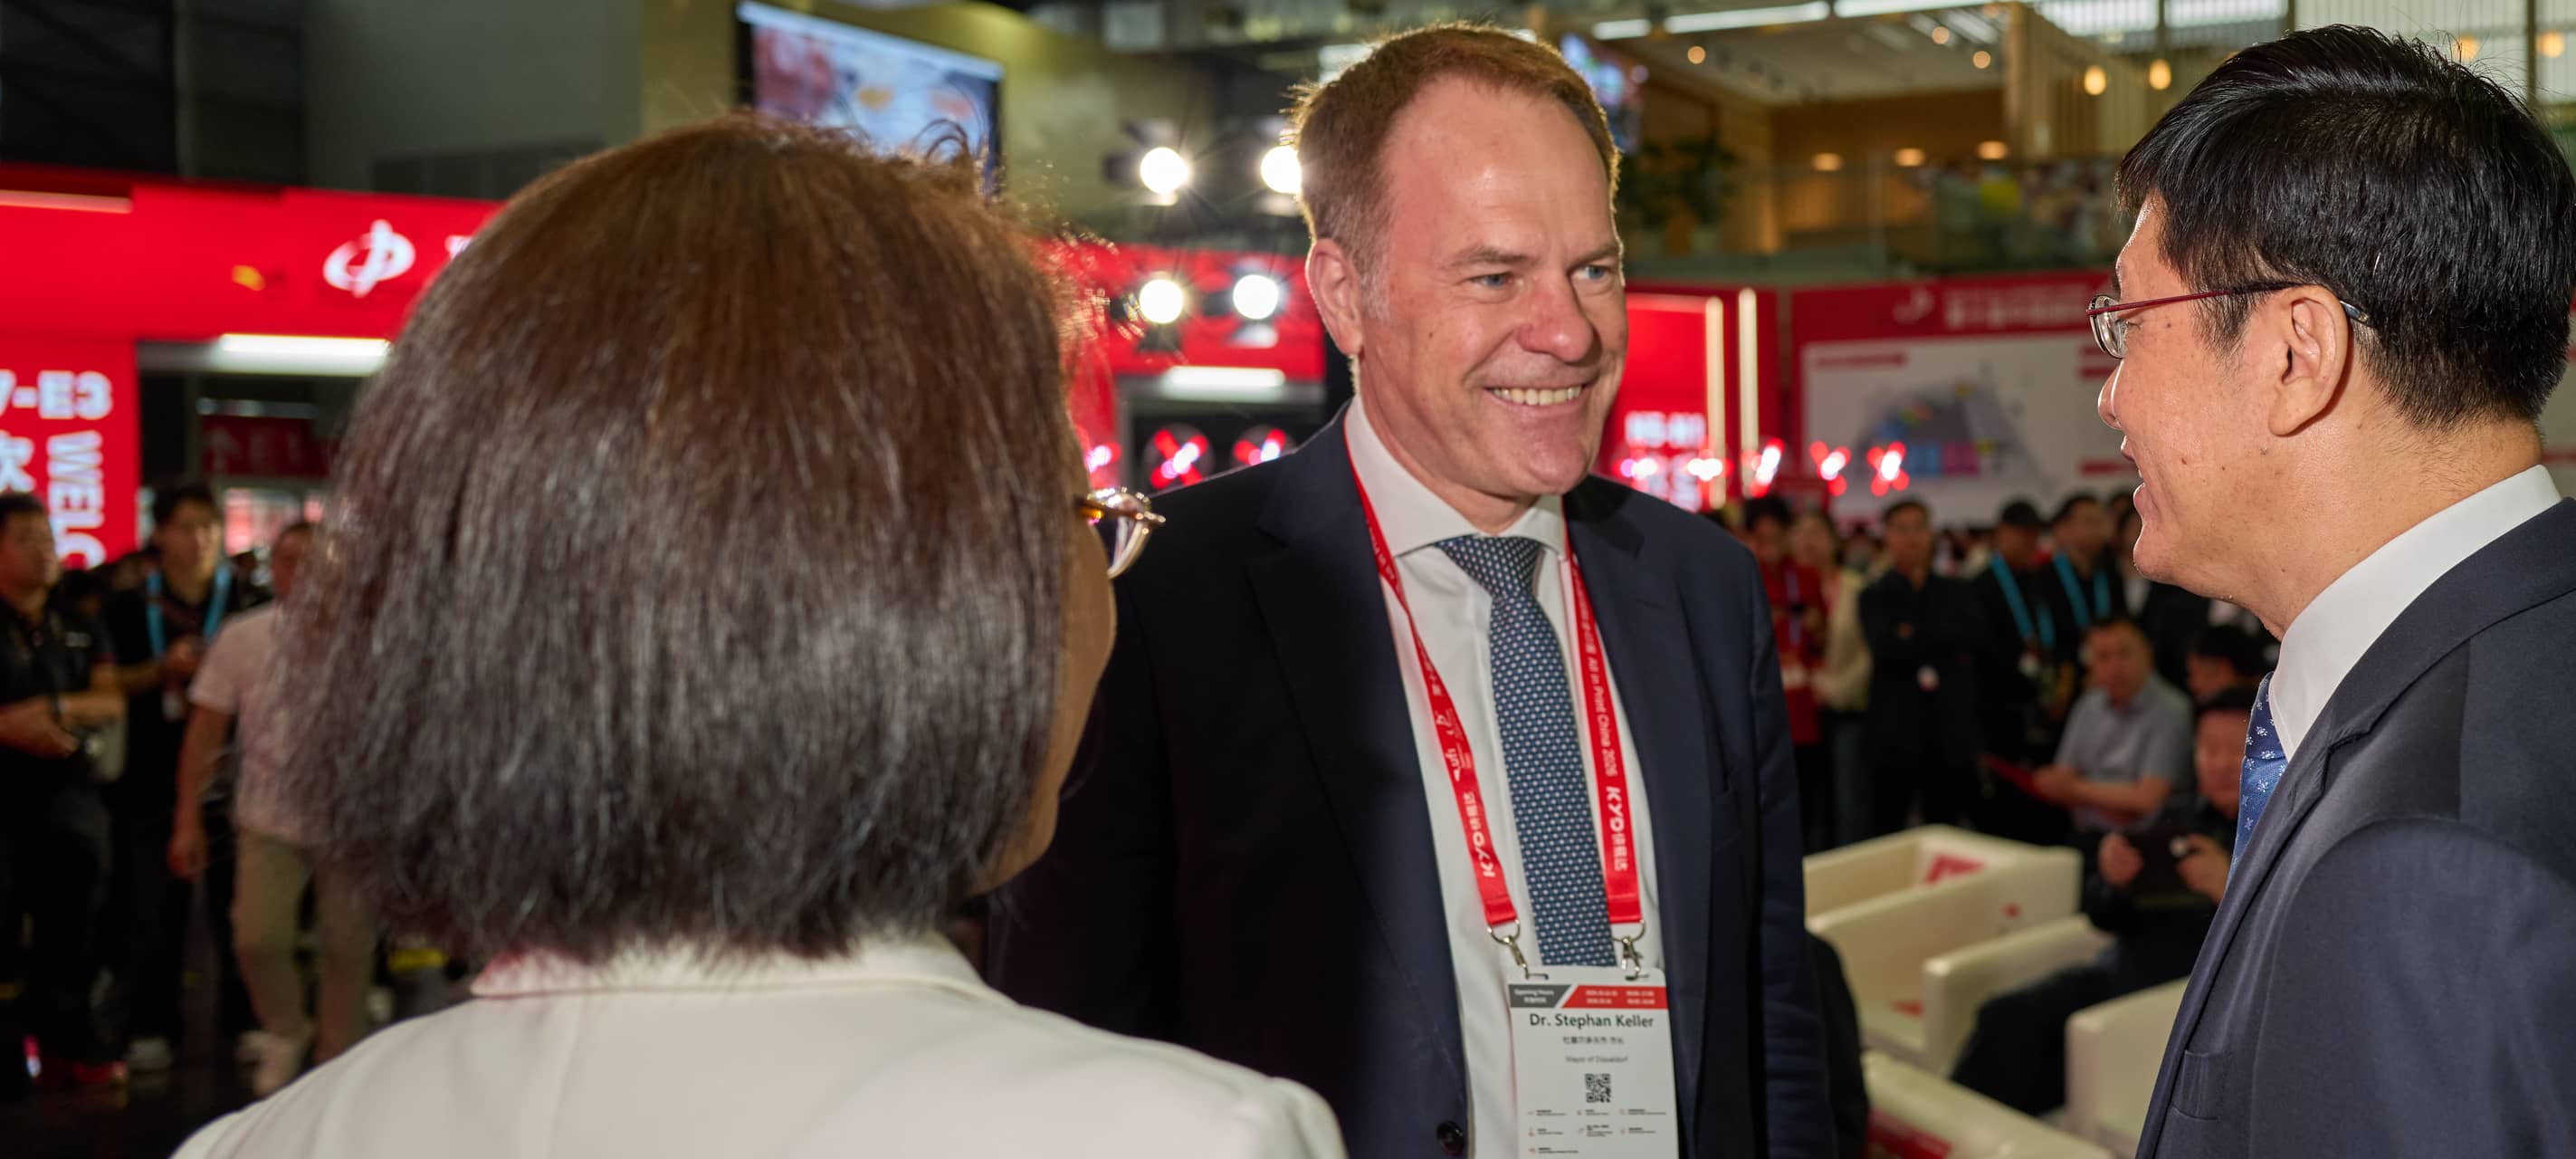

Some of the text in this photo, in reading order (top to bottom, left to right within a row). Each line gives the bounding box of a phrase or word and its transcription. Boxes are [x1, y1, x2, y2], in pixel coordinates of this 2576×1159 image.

[1594, 686, 1607, 713] Print
[1598, 714, 1611, 747] China
[1530, 1013, 1655, 1030] Dr. Stephan Keller
